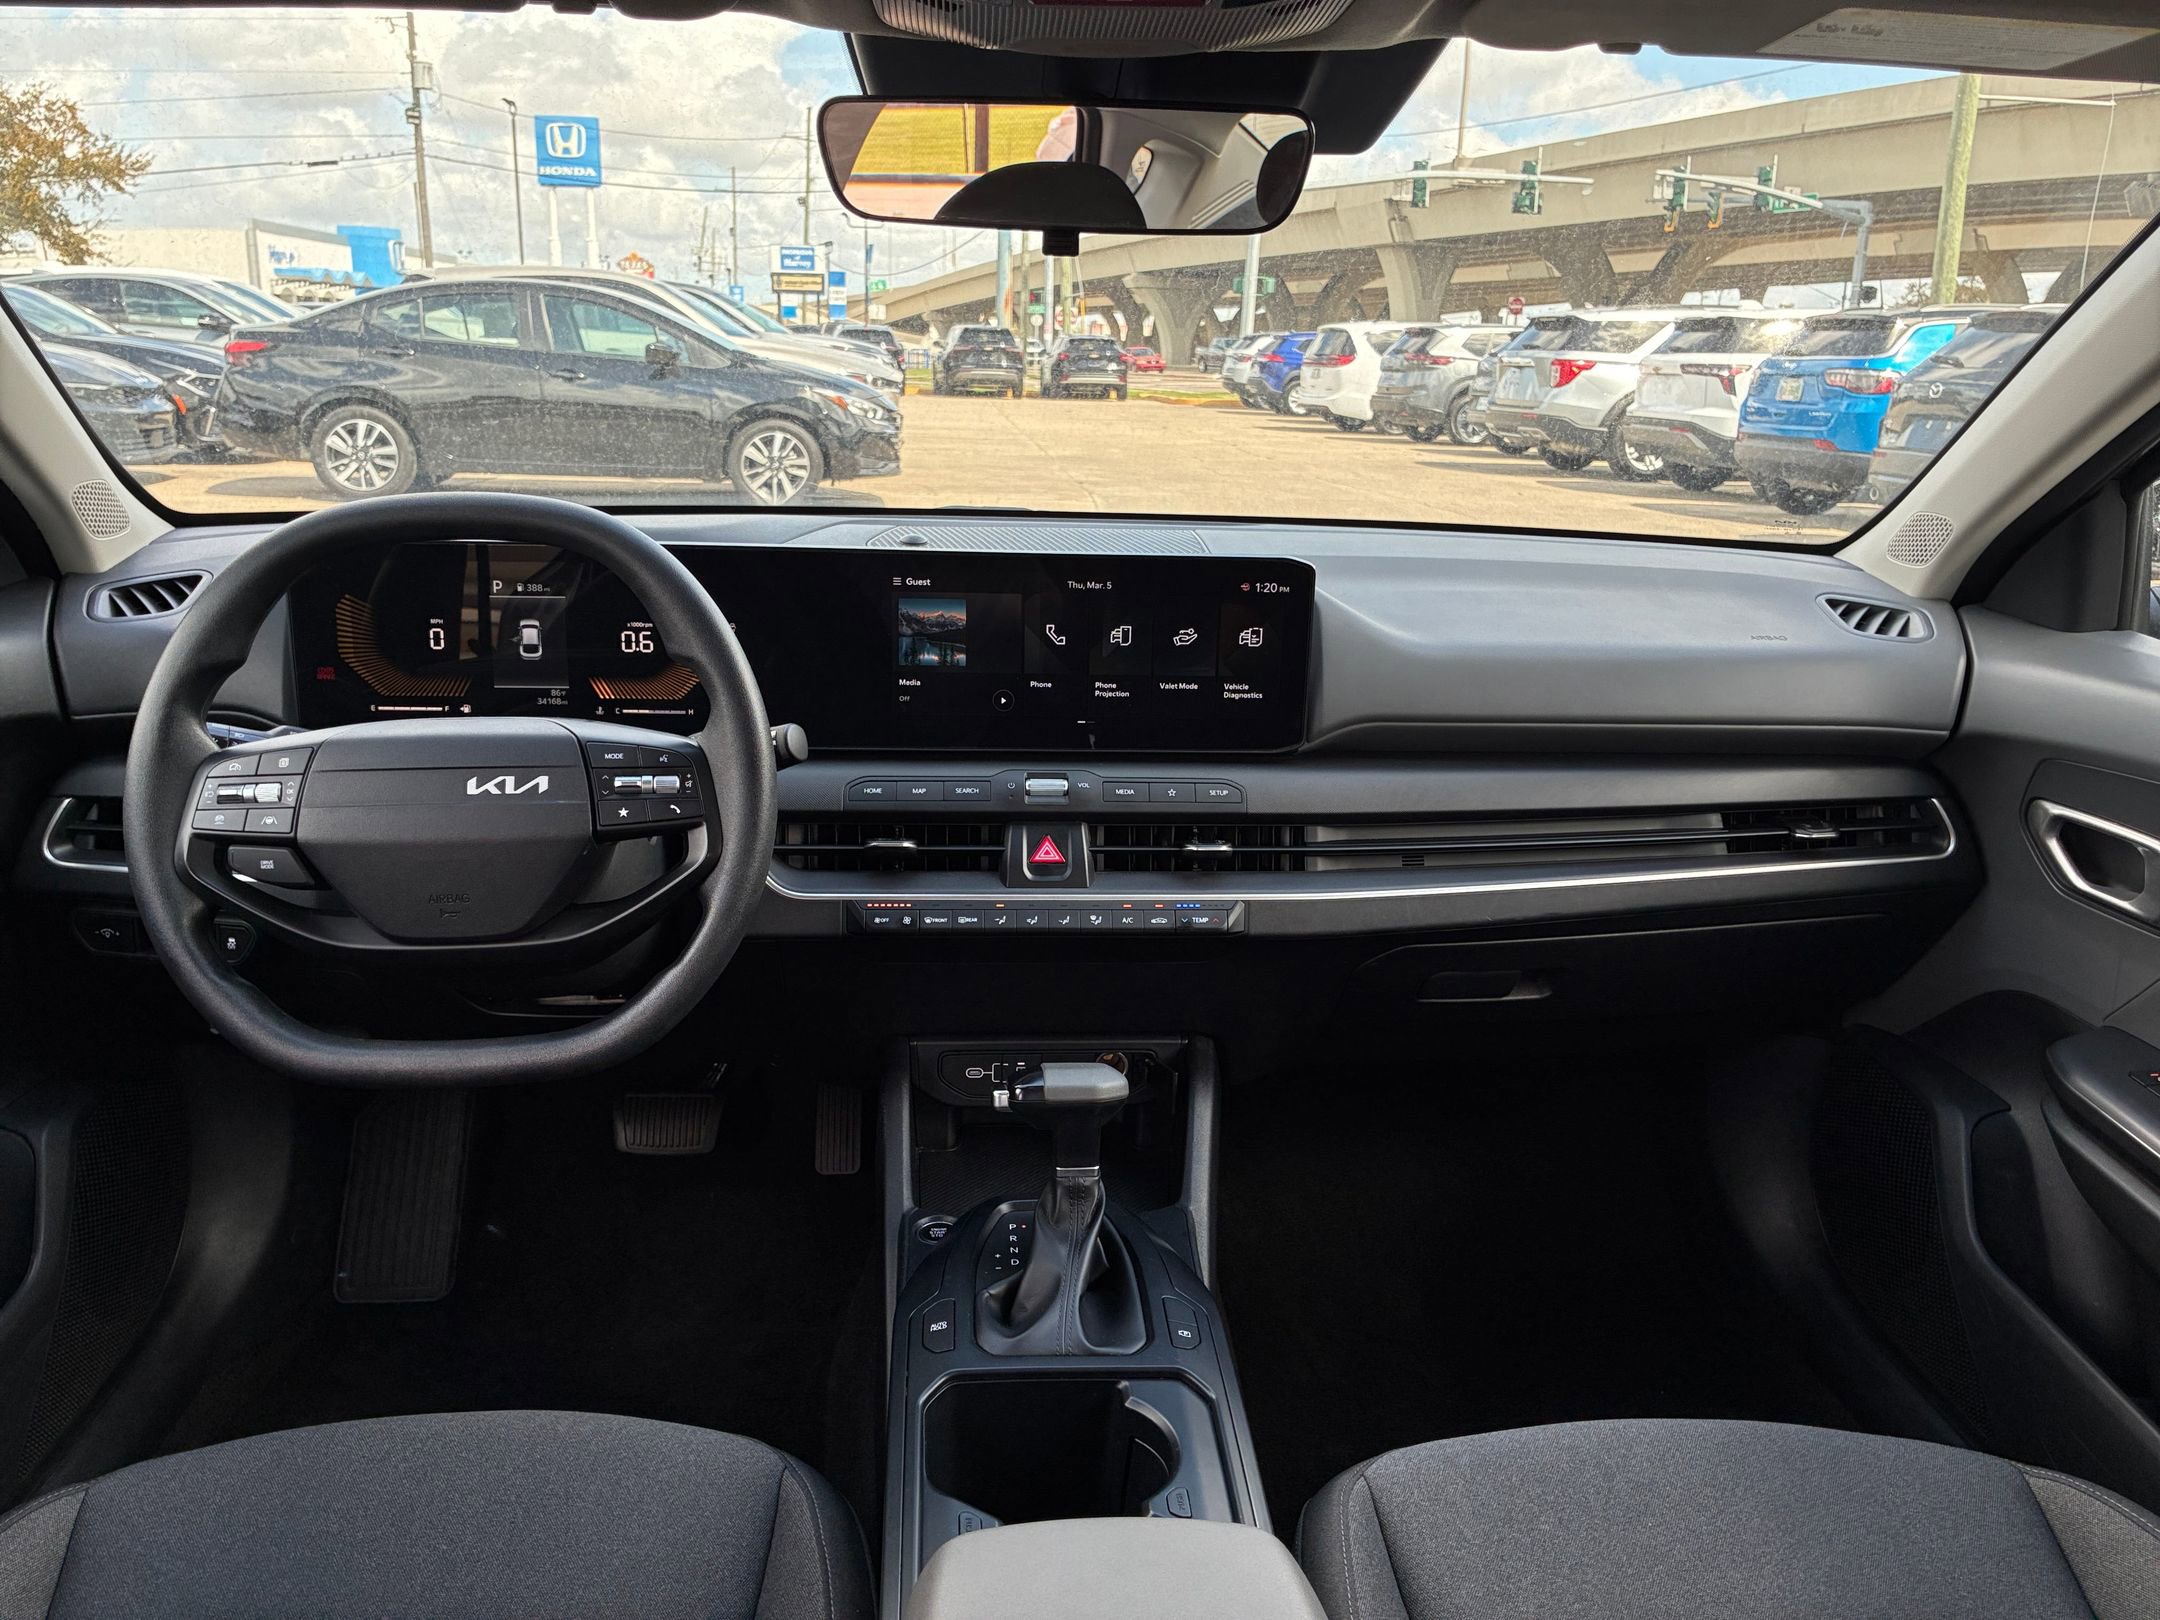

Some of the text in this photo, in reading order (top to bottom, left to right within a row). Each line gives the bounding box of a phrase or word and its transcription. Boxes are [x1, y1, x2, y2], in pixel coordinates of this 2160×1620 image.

[538, 166, 597, 177] HONDA
[905, 577, 931, 586] Guest
[1067, 581, 1112, 590] Thu, Mar. 5
[492, 580, 503, 594] P
[526, 583, 543, 592] 388
[1255, 582, 1278, 593] 1:20
[429, 627, 445, 650] 0
[621, 631, 654, 653] 0.6
[1159, 682, 1179, 690] Valet
[1094, 690, 1130, 698] Projection
[1223, 691, 1263, 700] Diagnostics
[466, 775, 549, 795] KIA
[863, 787, 883, 795] HOME
[912, 787, 927, 795] MAP
[428, 893, 471, 904] AIRBAG
[1122, 916, 1134, 924] A/C
[1191, 916, 1209, 924] TEMP
